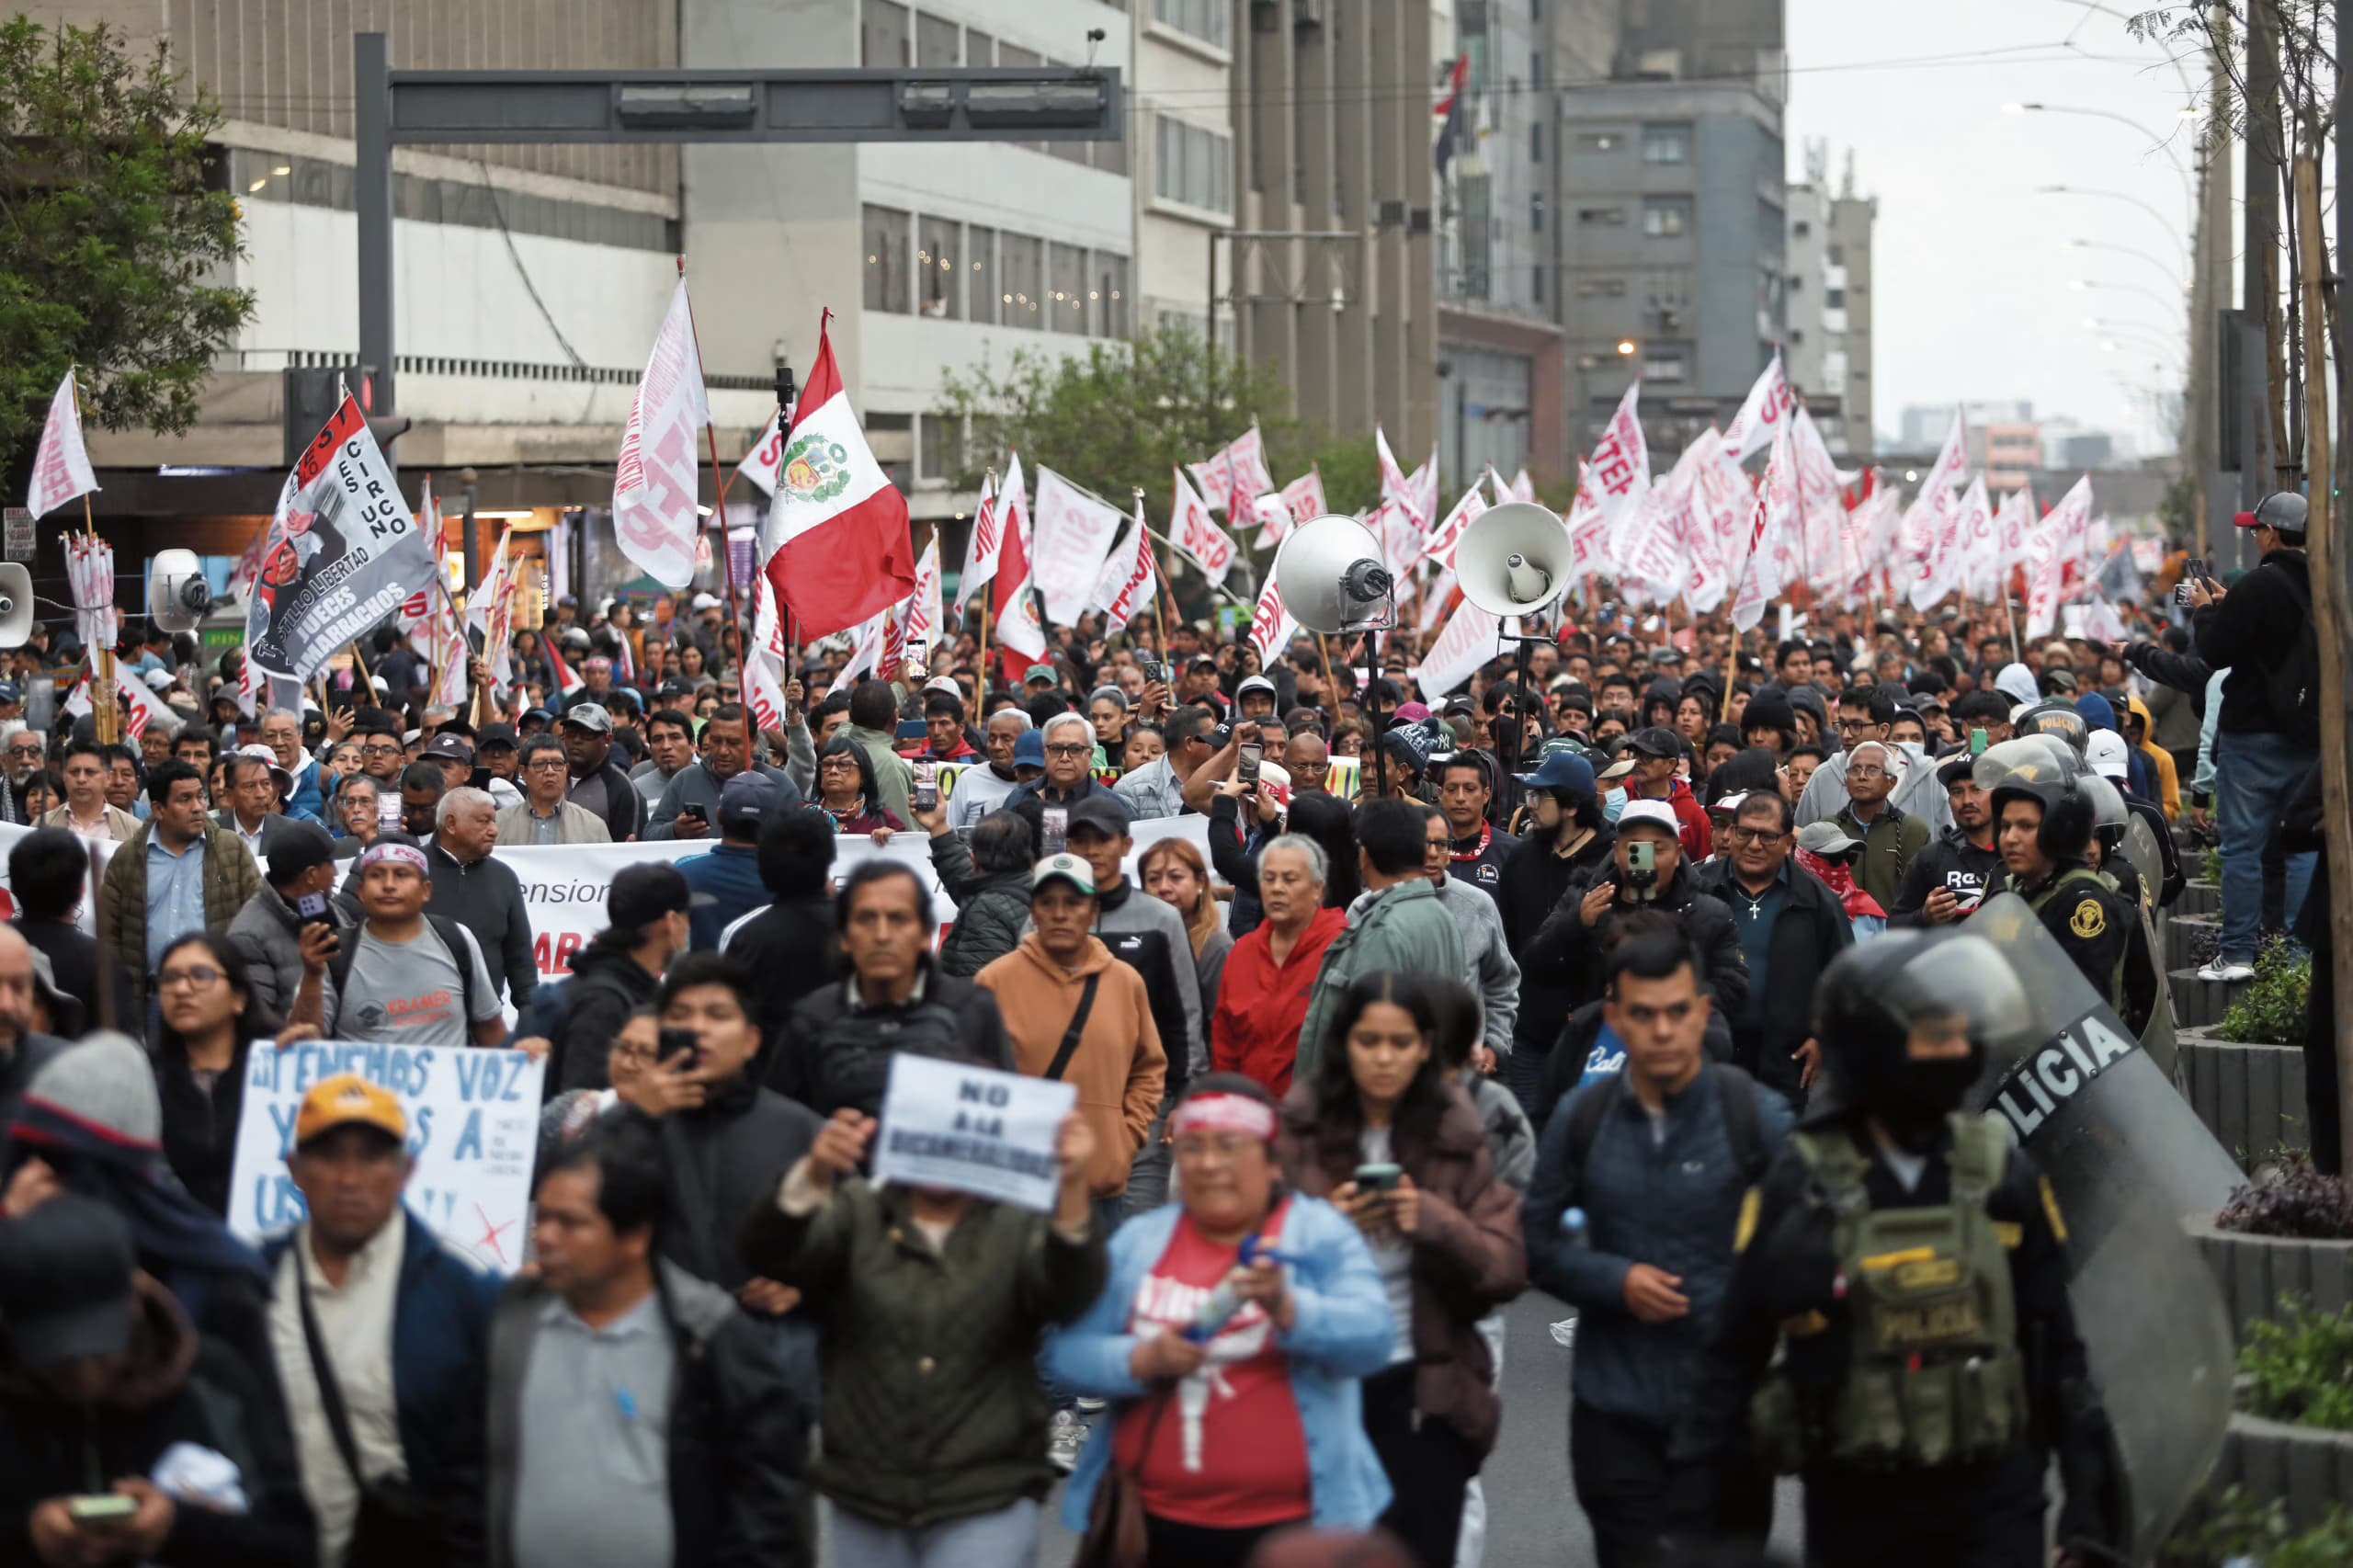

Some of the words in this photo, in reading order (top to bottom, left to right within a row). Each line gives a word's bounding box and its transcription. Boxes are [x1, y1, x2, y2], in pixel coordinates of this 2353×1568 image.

[347, 441, 406, 535] CIRCO
[309, 546, 369, 596] LIBERTAD
[293, 582, 406, 681] AMARRACHOS
[297, 585, 358, 643] JUECES
[1438, 733, 1450, 750] NY
[387, 991, 452, 1018] KRAMER
[456, 1052, 531, 1102] VOZ
[960, 1078, 1009, 1108] NO
[1985, 1016, 2131, 1149] LICIA
